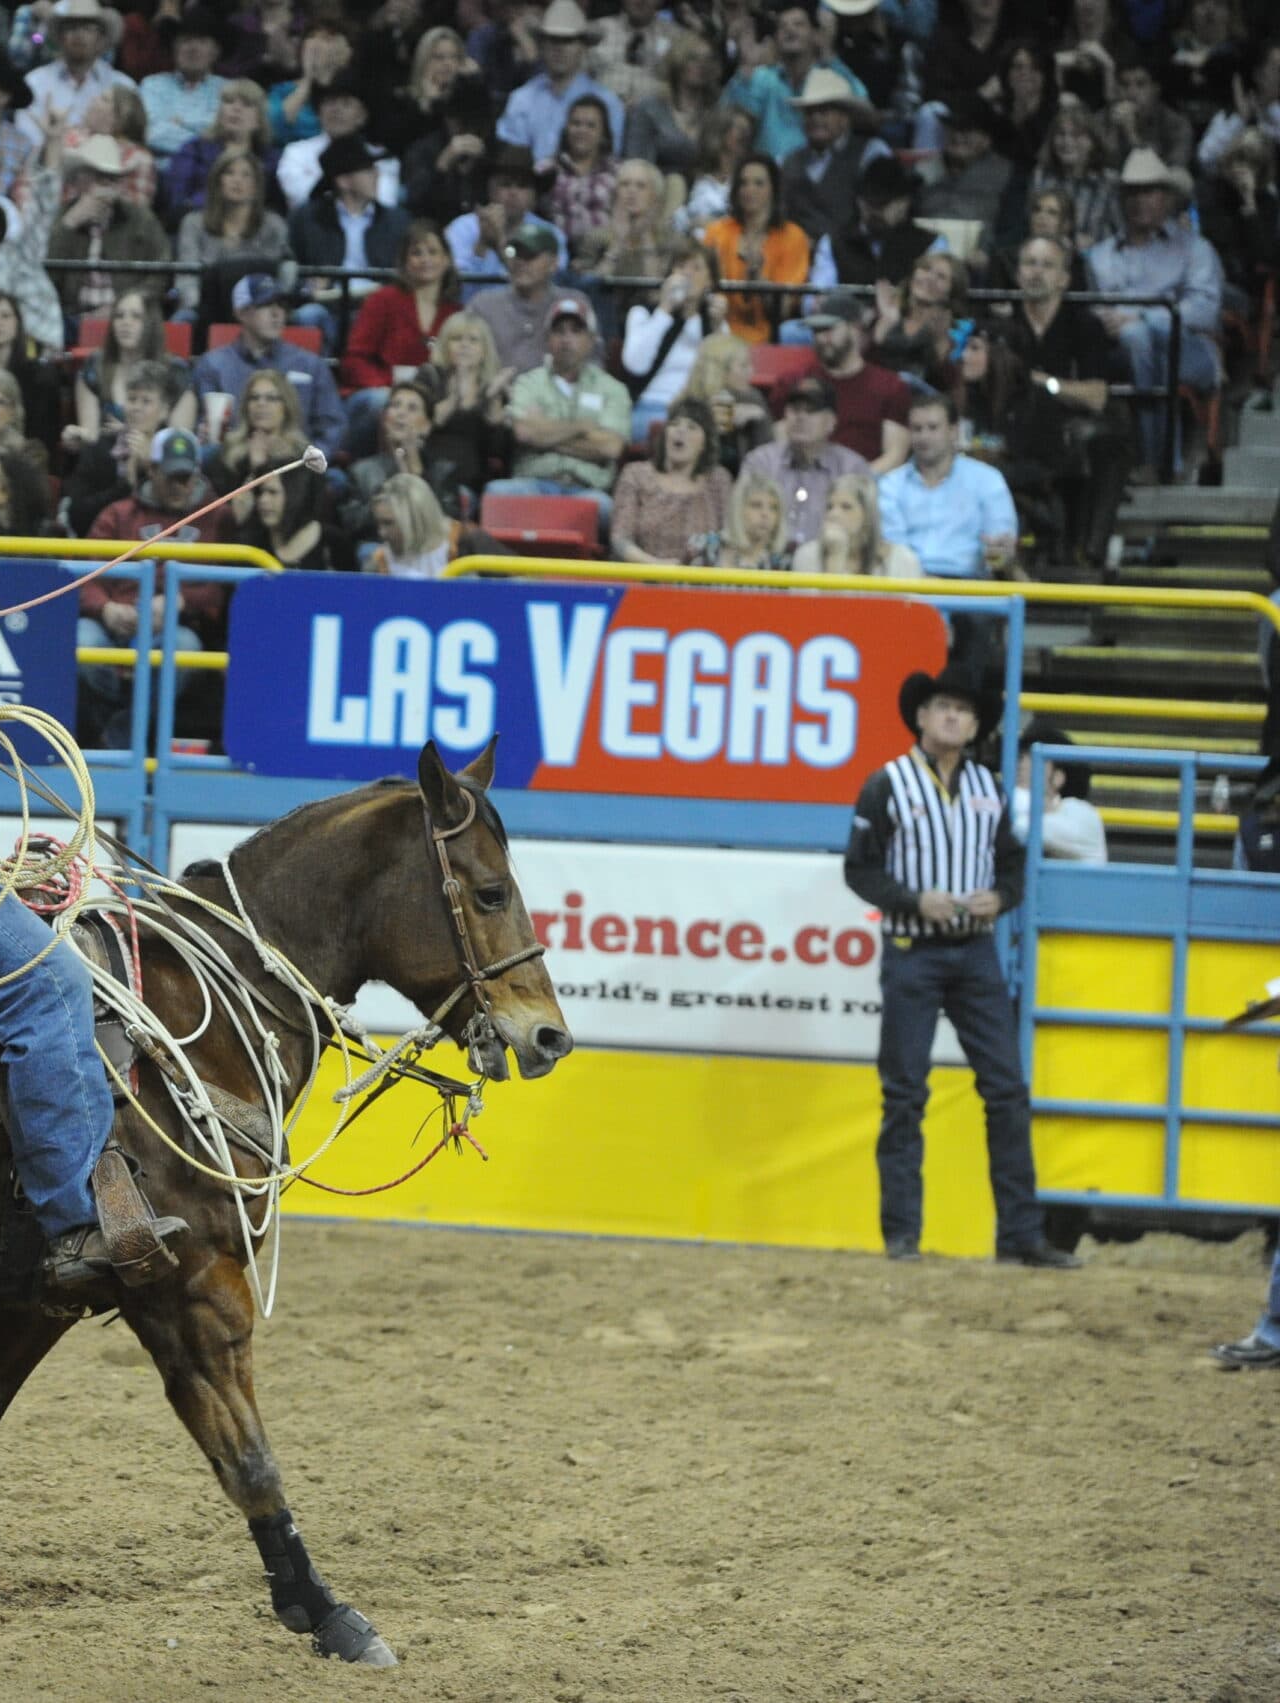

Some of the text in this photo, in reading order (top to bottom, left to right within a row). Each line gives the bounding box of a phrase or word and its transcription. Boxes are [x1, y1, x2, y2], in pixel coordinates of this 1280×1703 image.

[307, 601, 861, 769] LAS VEGAS
[669, 989, 831, 1013] greatest
